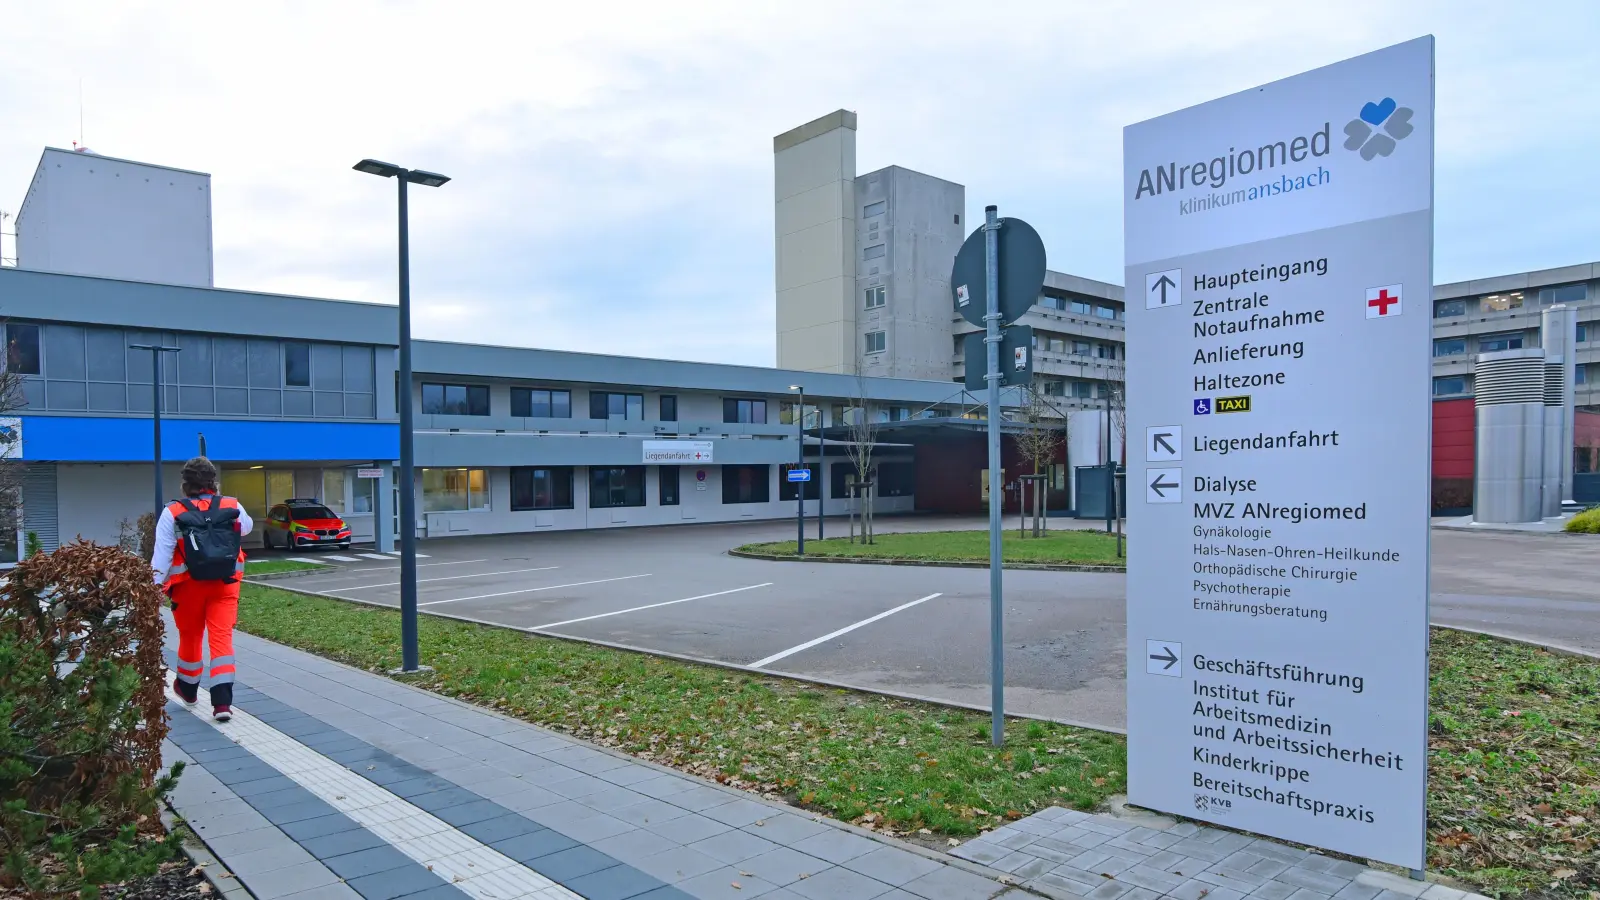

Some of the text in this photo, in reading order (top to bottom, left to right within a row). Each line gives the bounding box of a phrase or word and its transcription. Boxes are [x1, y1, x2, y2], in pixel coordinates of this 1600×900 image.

[1135, 122, 1331, 200] ANregiomed
[1194, 257, 1329, 291] Haupteingang
[1193, 292, 1269, 317] Zentrale
[1194, 309, 1325, 338] Notaufnahme
[1193, 340, 1305, 365] Anlieferung
[1194, 371, 1286, 392] Haltezone
[1218, 399, 1247, 411] TAXI
[1194, 430, 1340, 455] Liegendanfahrt
[645, 451, 691, 461] Liegendanfahrt
[1194, 476, 1257, 496] Dialyse
[1194, 503, 1367, 523] MVZ ANregiomed
[1193, 525, 1272, 541] Gynäkologie
[1193, 544, 1400, 563] Hals-Nasen-Ohren-Heilkunde
[1193, 562, 1358, 583] Orthopädische Chirurgie
[1193, 580, 1292, 599] Psychotherapie
[1193, 598, 1328, 622] Ernährungsberatung
[1193, 654, 1364, 693] Geschäftsführung
[1193, 680, 1295, 708] Institut für
[1193, 701, 1332, 736] Arbeitsmedizin
[1193, 725, 1404, 770] und Arbeitssicherheit
[1193, 747, 1310, 783] Kinderkrippe
[1193, 772, 1375, 823] Bereitschaftspraxis
[1211, 797, 1232, 808] KVB
